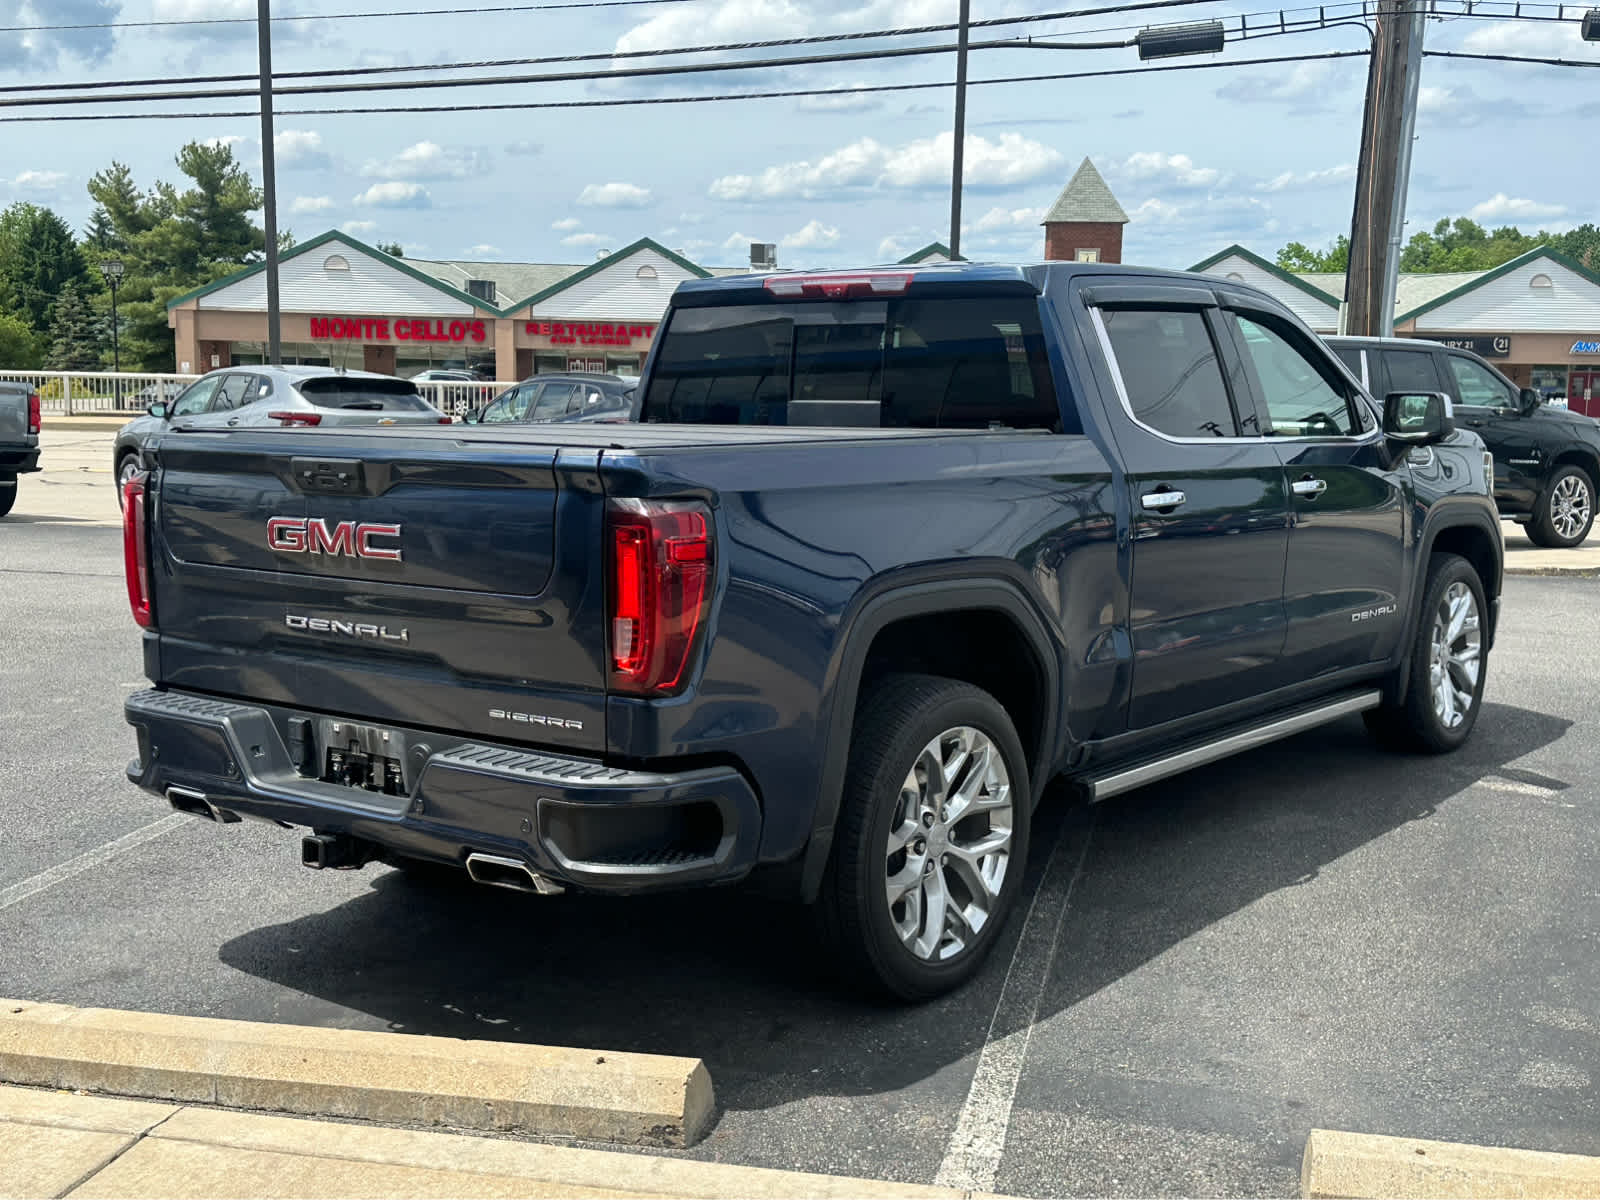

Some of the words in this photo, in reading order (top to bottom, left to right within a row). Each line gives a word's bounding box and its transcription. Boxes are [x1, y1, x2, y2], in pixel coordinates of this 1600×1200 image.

[310, 317, 390, 340] MONTE
[394, 319, 486, 343] CELLO'S
[525, 322, 655, 339] RESTAURANT
[550, 336, 576, 345] AND
[1464, 340, 1473, 349] 21
[266, 515, 402, 562] GMC
[1351, 604, 1397, 622] DENALI
[285, 614, 408, 641] DENALI
[488, 708, 583, 730] SIERRA
